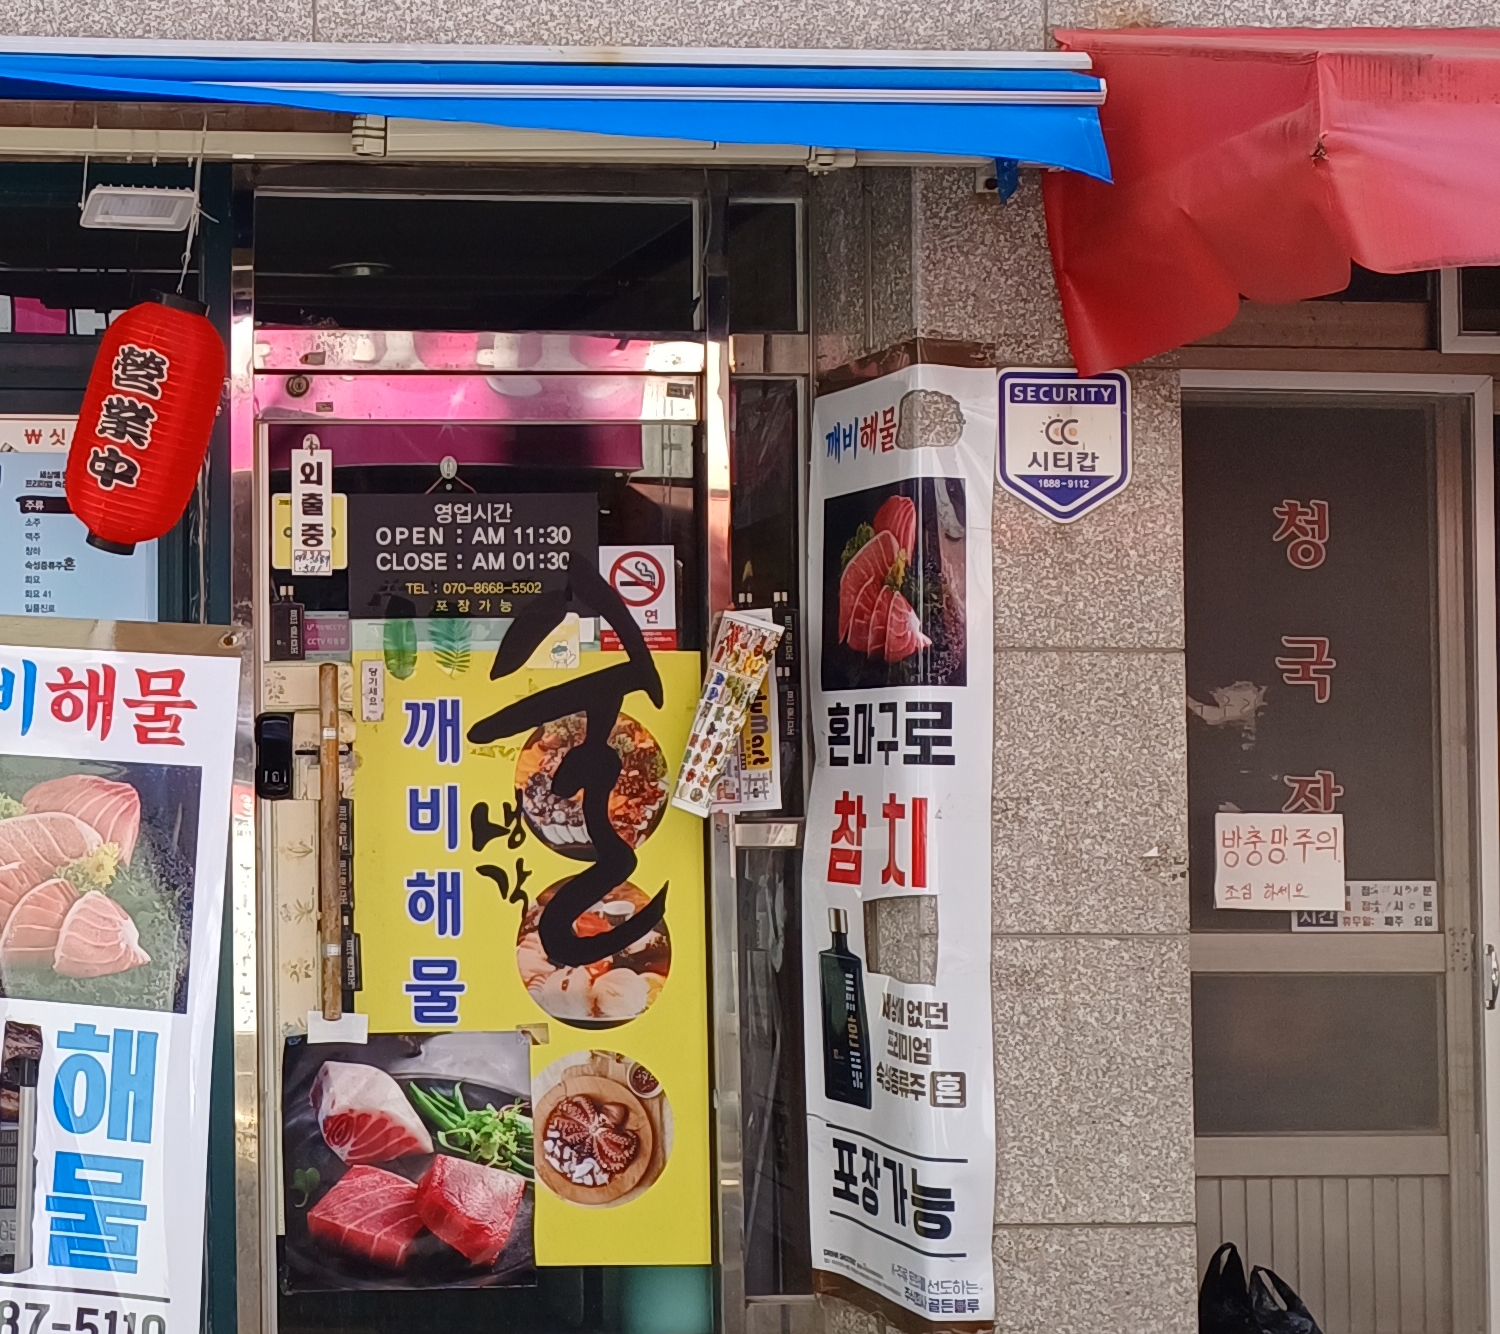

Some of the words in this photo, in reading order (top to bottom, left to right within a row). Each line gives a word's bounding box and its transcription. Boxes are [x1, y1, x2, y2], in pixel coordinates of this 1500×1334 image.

[1013, 386, 1112, 403] SECURITY
[87, 344, 169, 491] 營業中
[826, 410, 898, 463] 깨비해물
[1027, 451, 1100, 472] 시티캅
[300, 462, 324, 548] 외출중
[434, 503, 513, 524] 영업시간
[25, 518, 41, 527] 소주
[375, 527, 444, 546] OPEN
[472, 527, 505, 545] AM
[514, 526, 571, 545] 11:30
[376, 552, 447, 571] CLOSE
[472, 552, 505, 571] AM
[513, 552, 570, 570] 01:30
[405, 582, 429, 595] TEL
[443, 581, 542, 594] 070-8668-5502
[368, 667, 378, 706] 당기세요
[827, 701, 956, 767] 혼마구로
[827, 791, 928, 888] 참치
[403, 699, 465, 1023] 깨비해물
[1225, 883, 1252, 901] 조심
[1414, 915, 1433, 927] 요일
[907, 1000, 948, 1030] 없던
[45, 1023, 160, 1275] 해물
[831, 1137, 955, 1240] 포장가능
